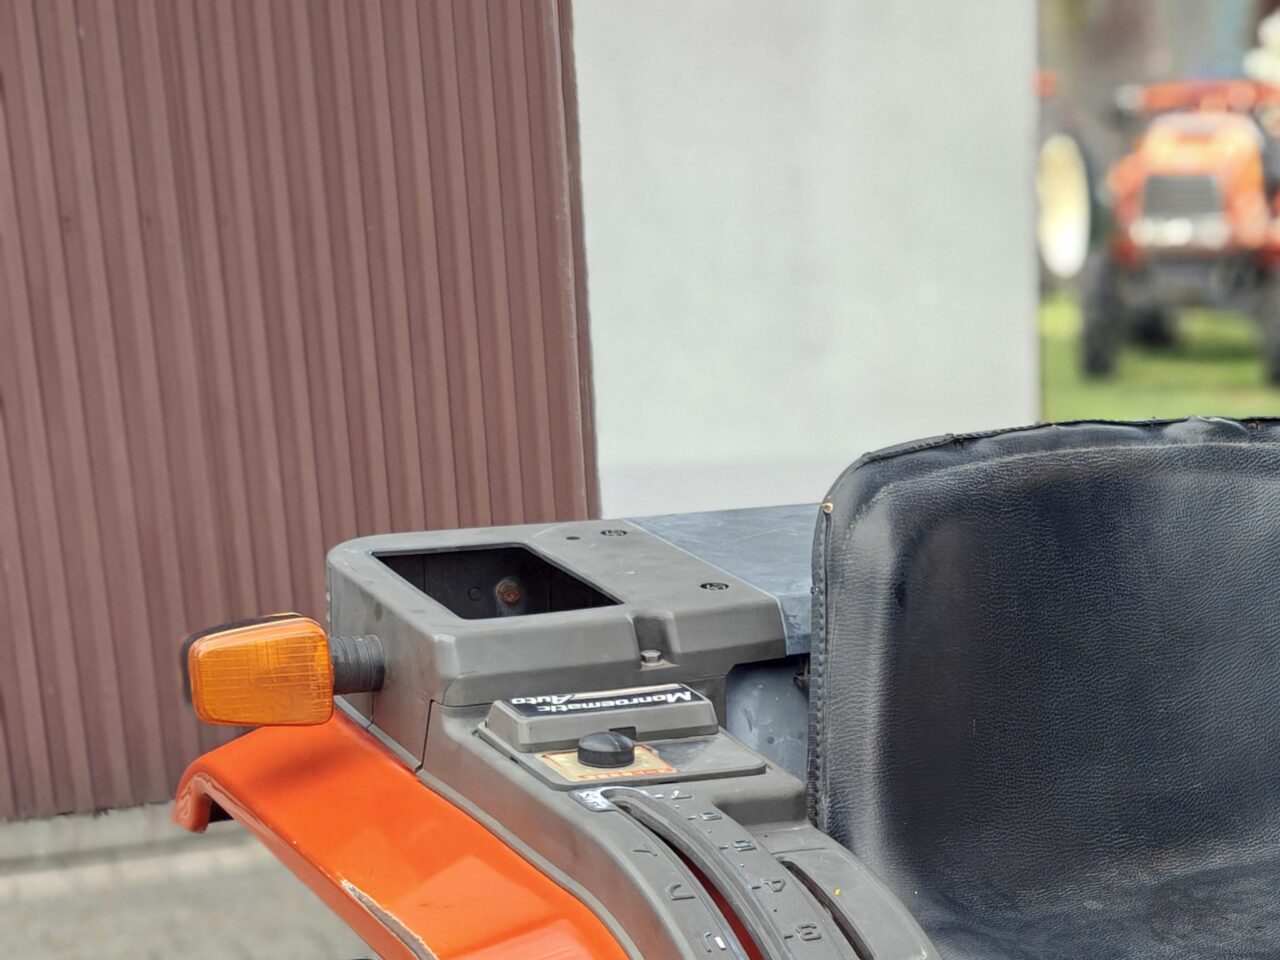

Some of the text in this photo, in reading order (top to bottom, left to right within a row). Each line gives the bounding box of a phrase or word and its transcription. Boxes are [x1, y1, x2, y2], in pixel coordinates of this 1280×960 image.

[511, 693, 573, 706] Auto
[538, 691, 691, 713] Monroematic
[796, 923, 823, 943] 3
